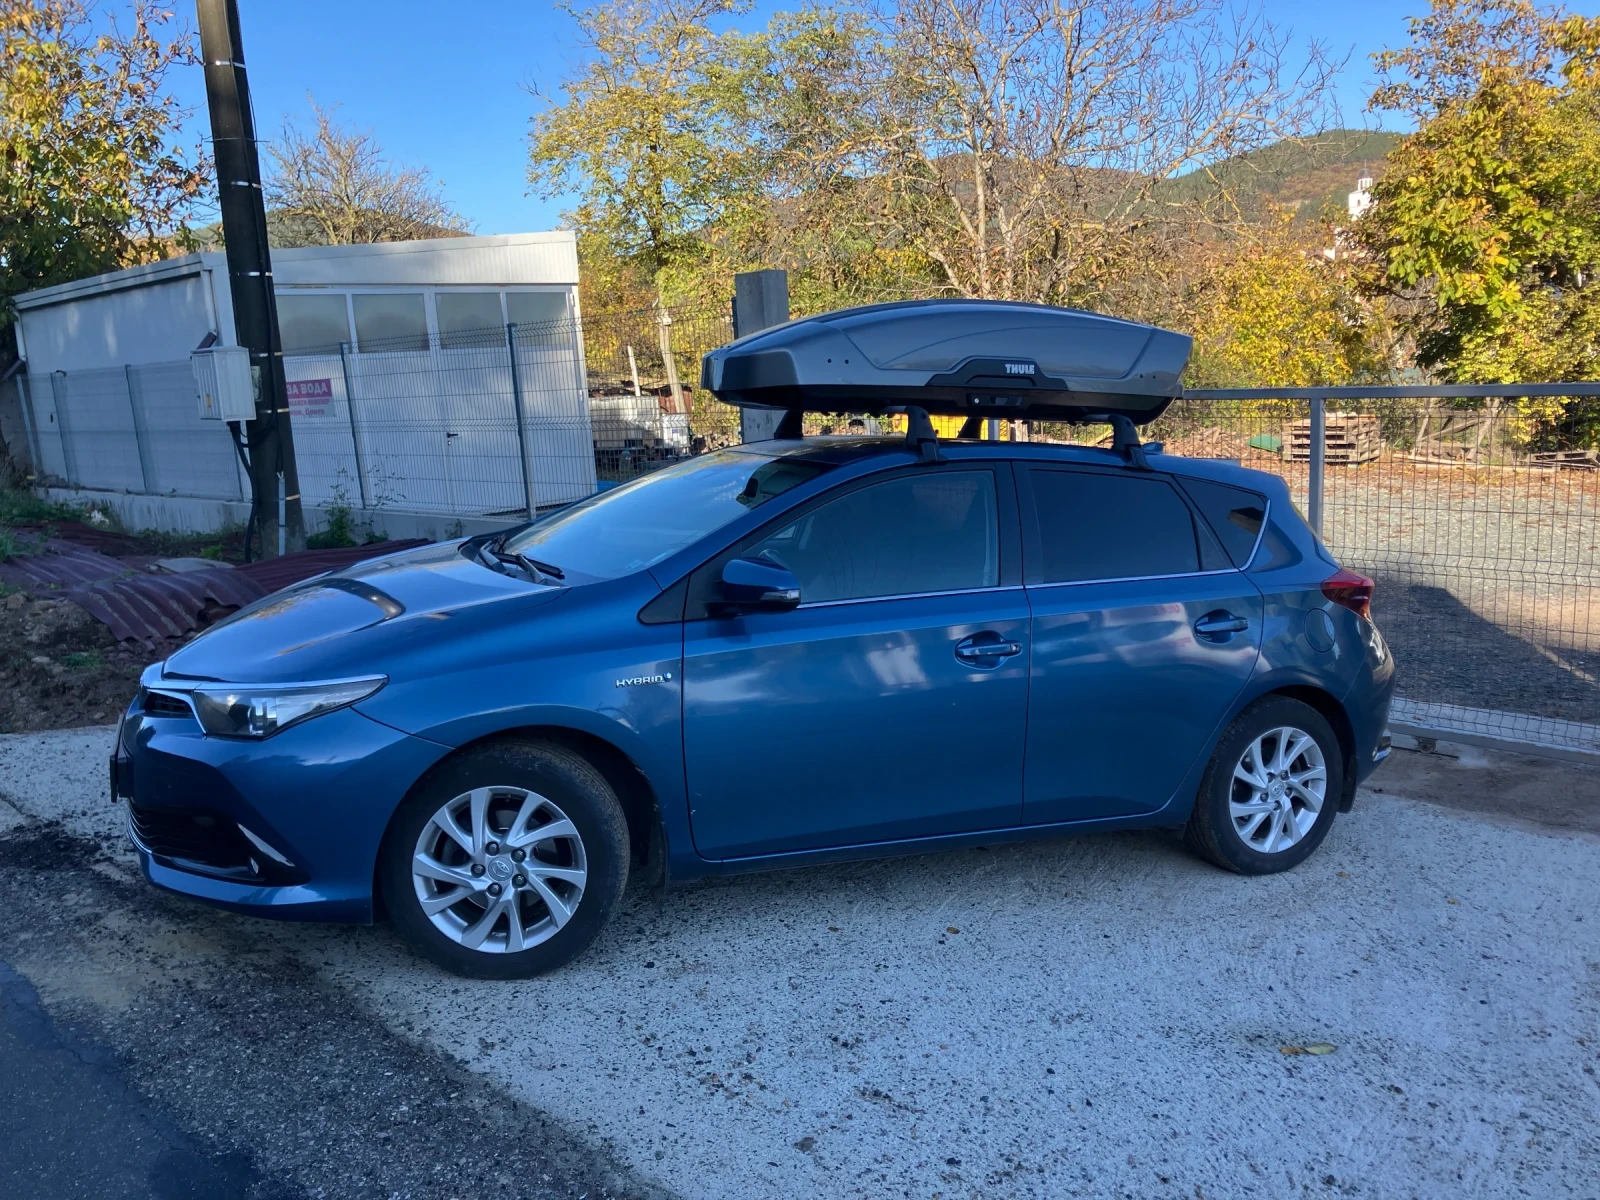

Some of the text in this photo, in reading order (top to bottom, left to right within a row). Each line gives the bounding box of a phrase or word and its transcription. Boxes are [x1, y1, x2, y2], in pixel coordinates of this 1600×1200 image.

[1005, 363, 1034, 374] THULE
[301, 382, 329, 395] ВОДА
[616, 675, 663, 687] HYBRID
